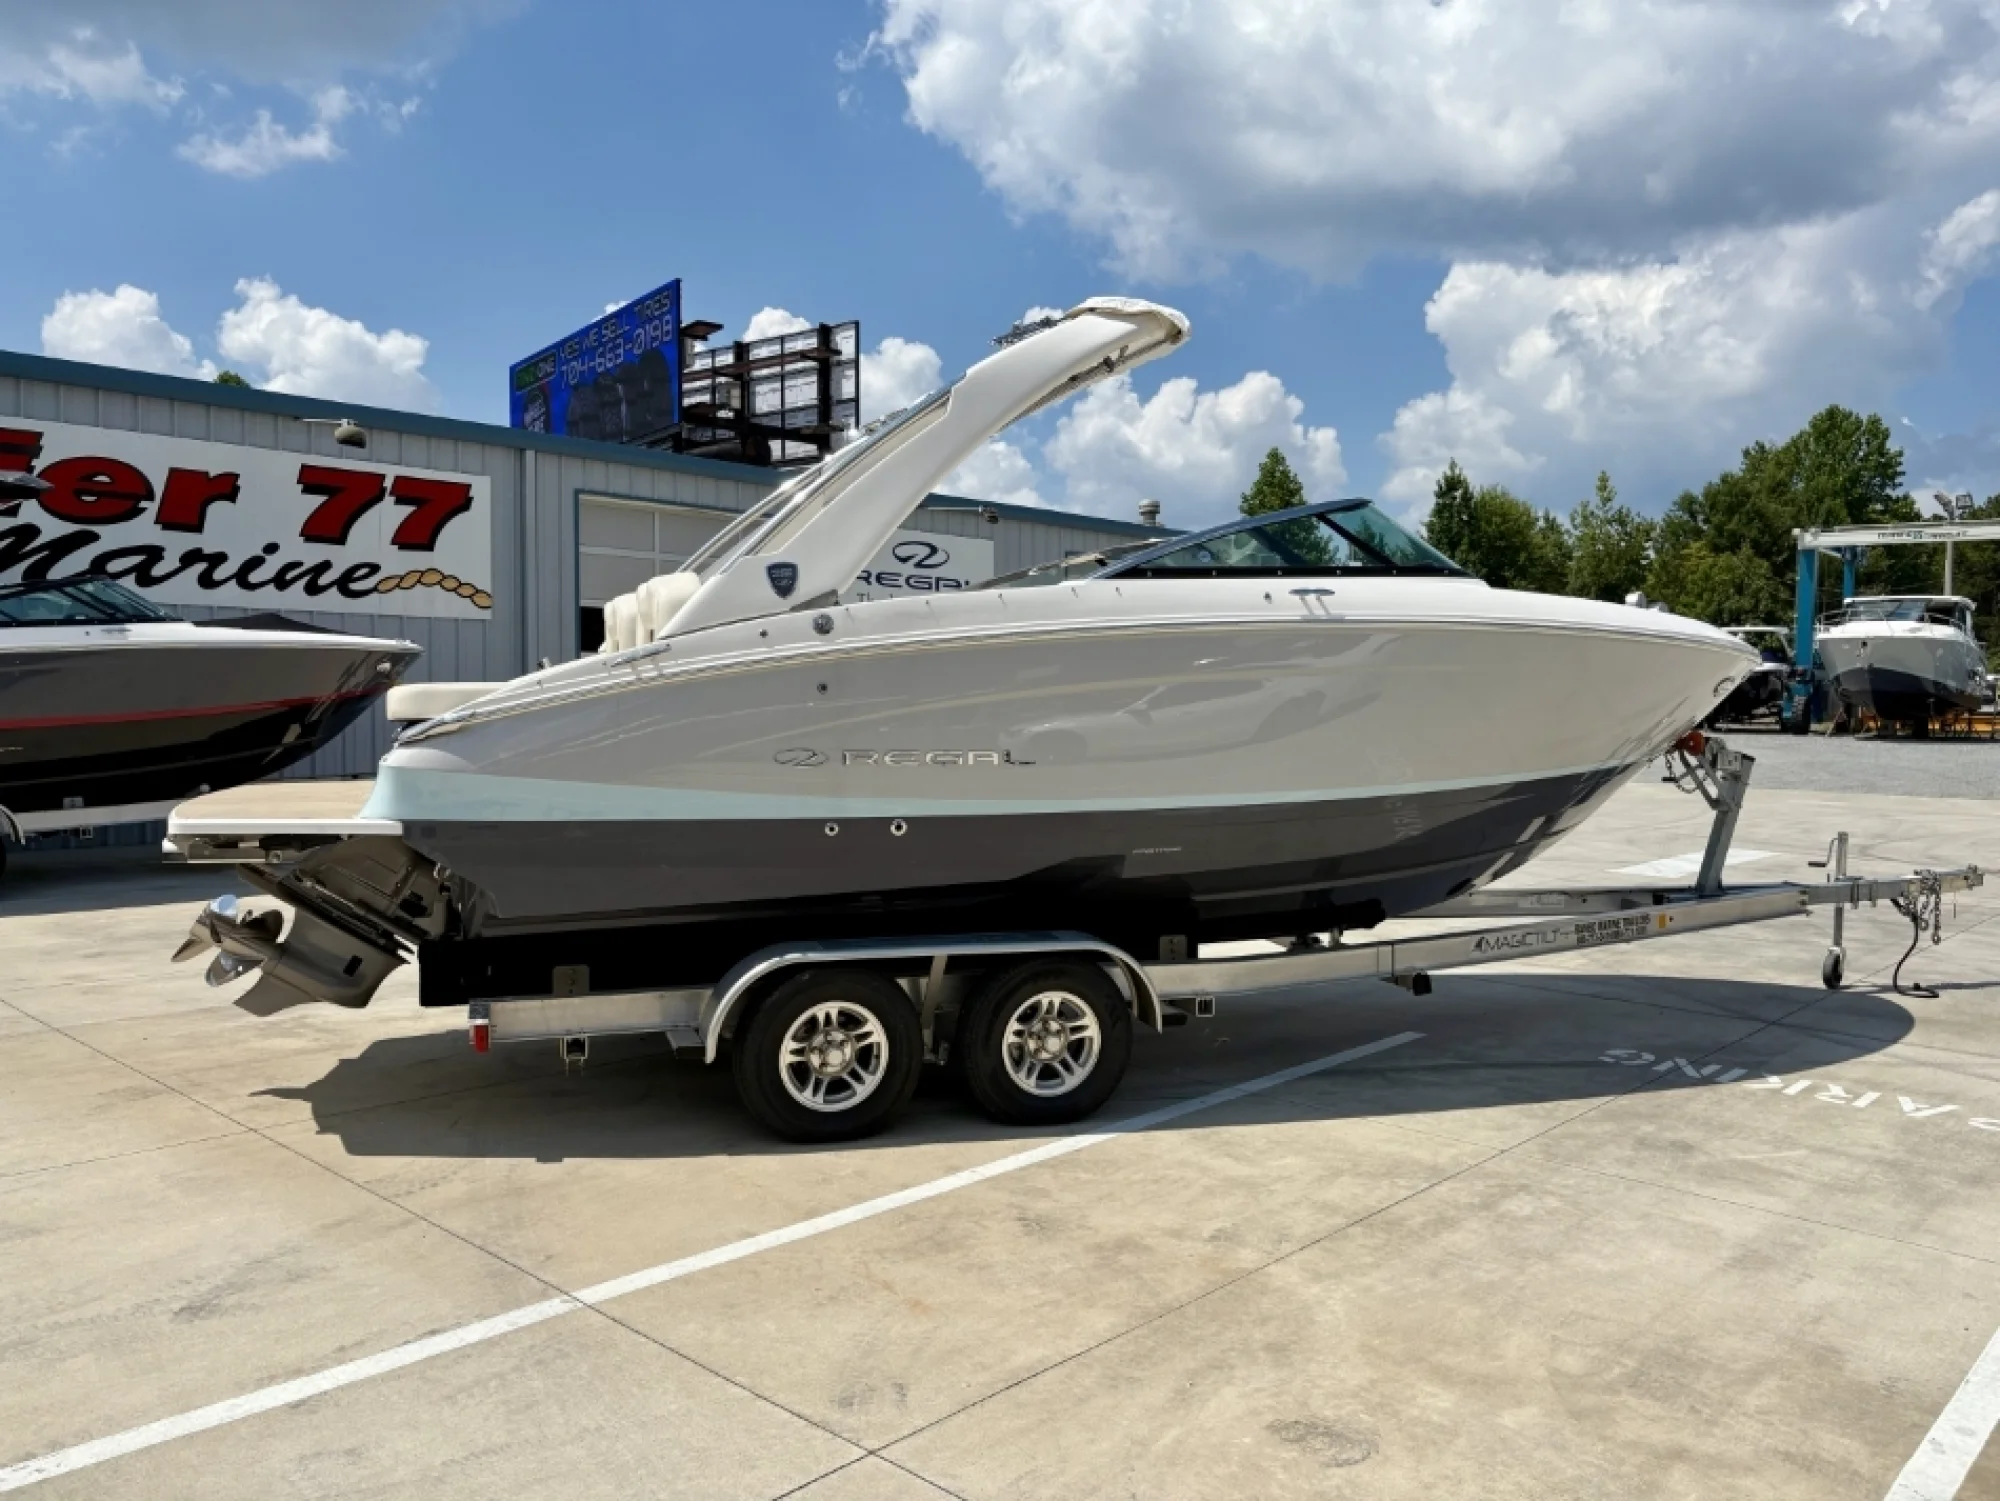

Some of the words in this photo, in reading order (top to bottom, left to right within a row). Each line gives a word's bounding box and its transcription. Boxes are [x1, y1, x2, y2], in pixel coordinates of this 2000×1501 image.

[560, 337, 580, 361] YES
[602, 314, 630, 342] SELL
[634, 290, 671, 320] TIRES
[561, 314, 673, 389] 704-663-0198
[298, 464, 474, 552] 77
[0, 521, 382, 599] Marine
[856, 569, 970, 593] REGA
[842, 749, 1036, 767] REGAL
